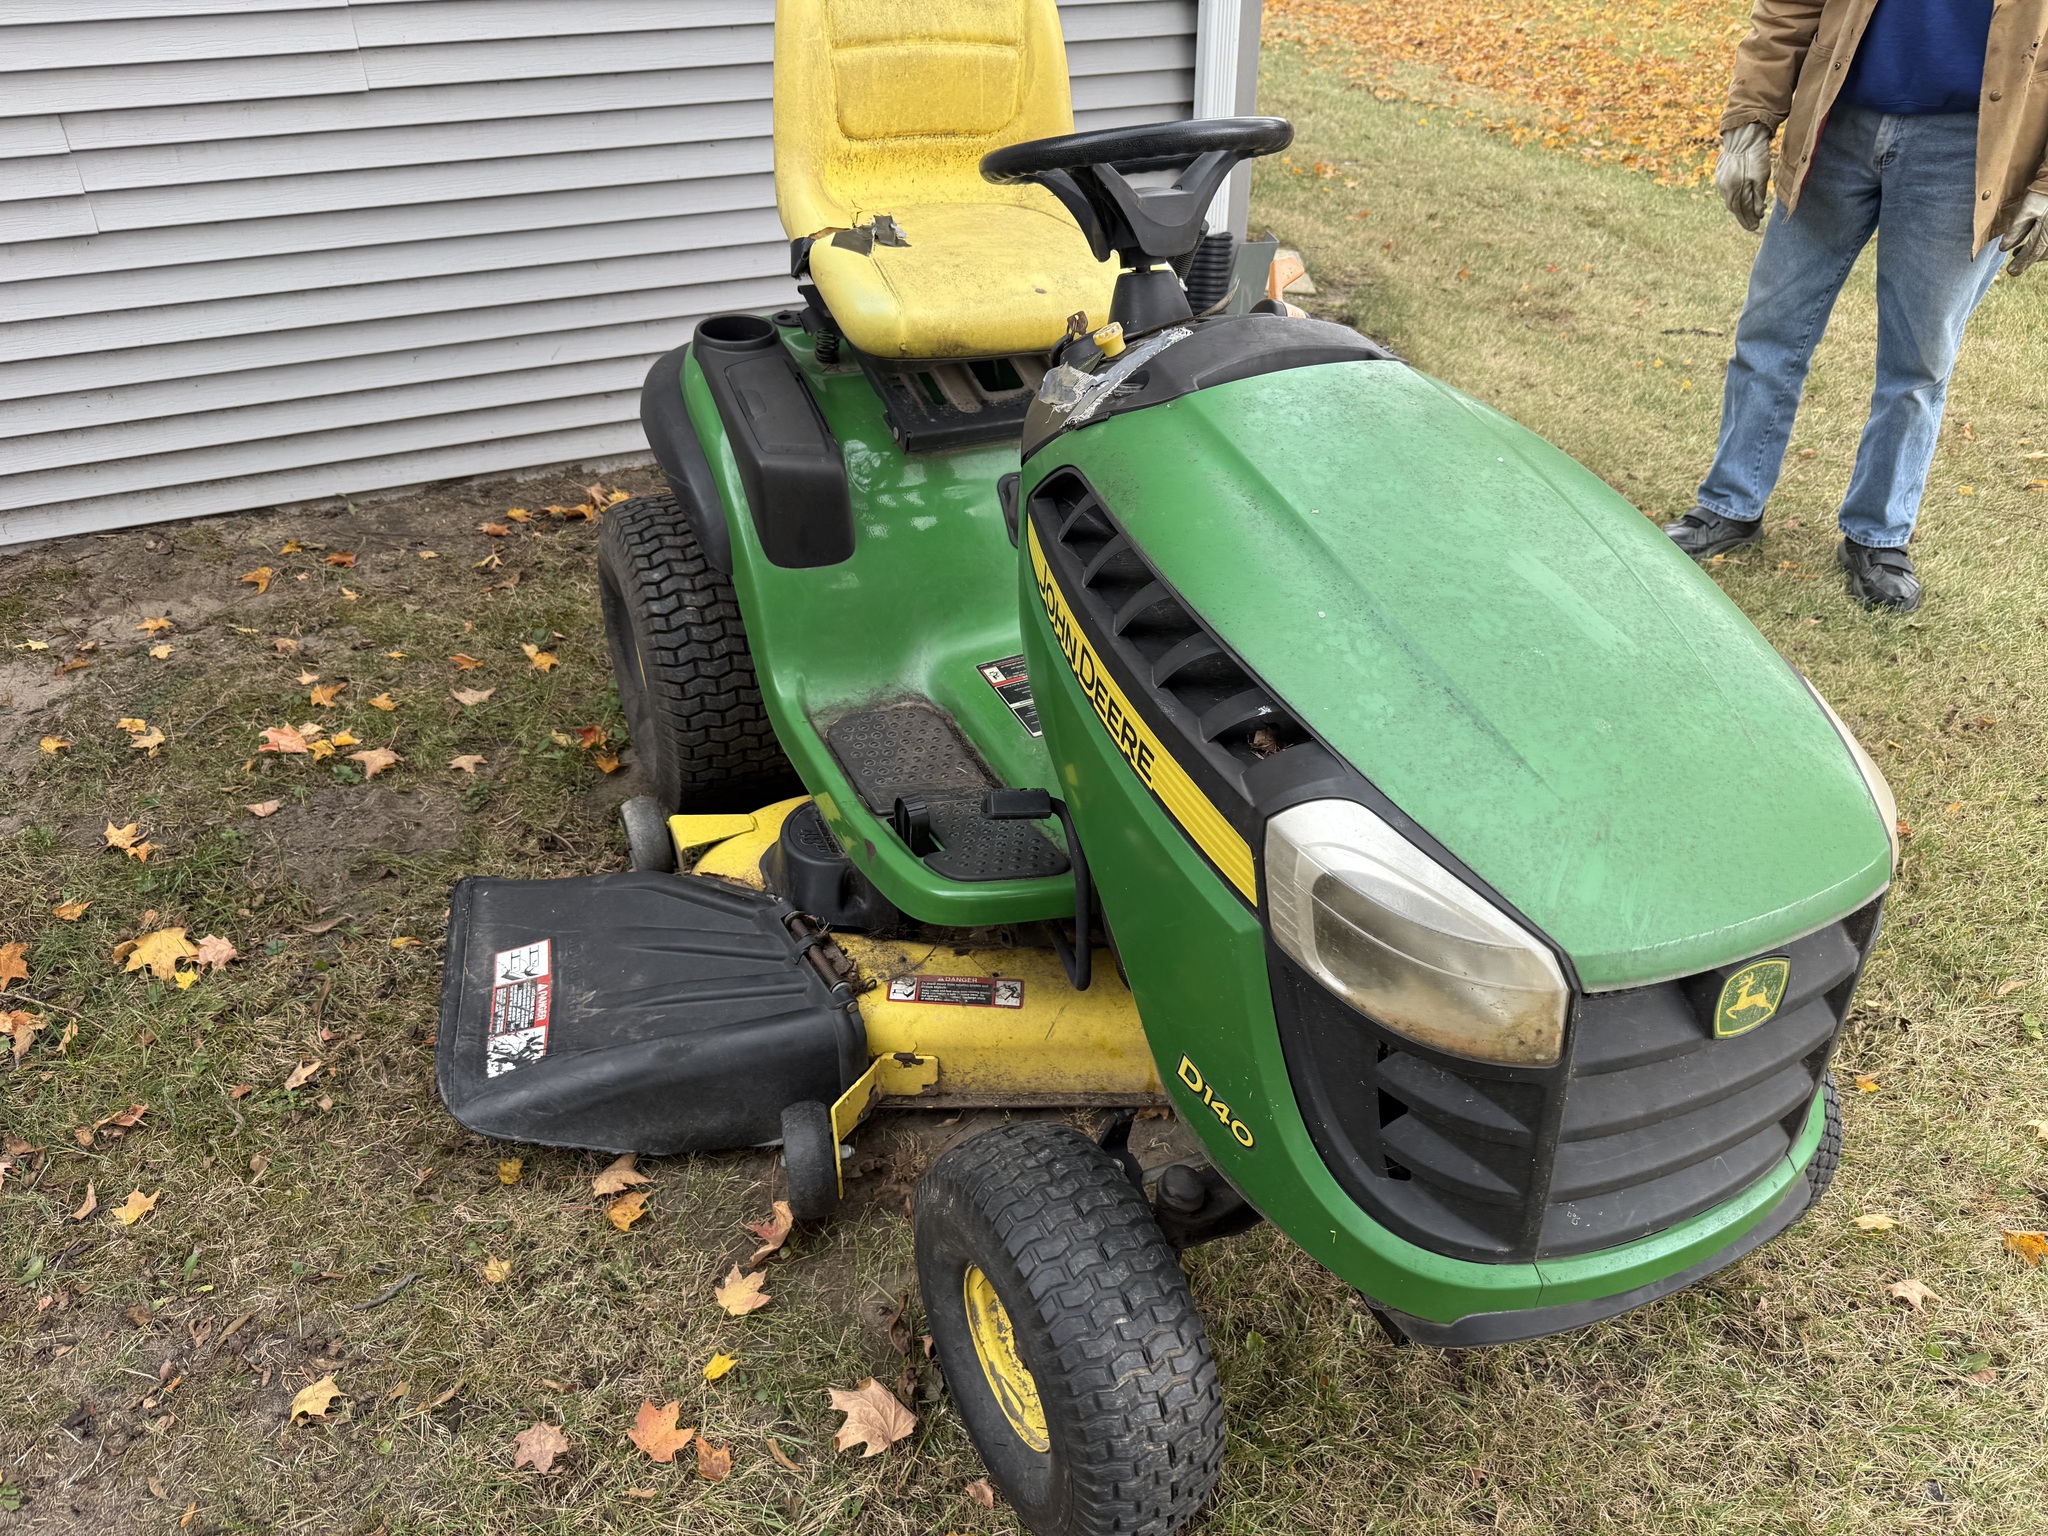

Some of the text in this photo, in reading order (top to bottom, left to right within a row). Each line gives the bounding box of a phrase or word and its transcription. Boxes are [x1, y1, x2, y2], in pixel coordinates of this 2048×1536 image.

[1038, 565, 1155, 783] JOHN DEERE
[536, 991, 547, 1021] DANGER
[1176, 1053, 1254, 1147] D140
